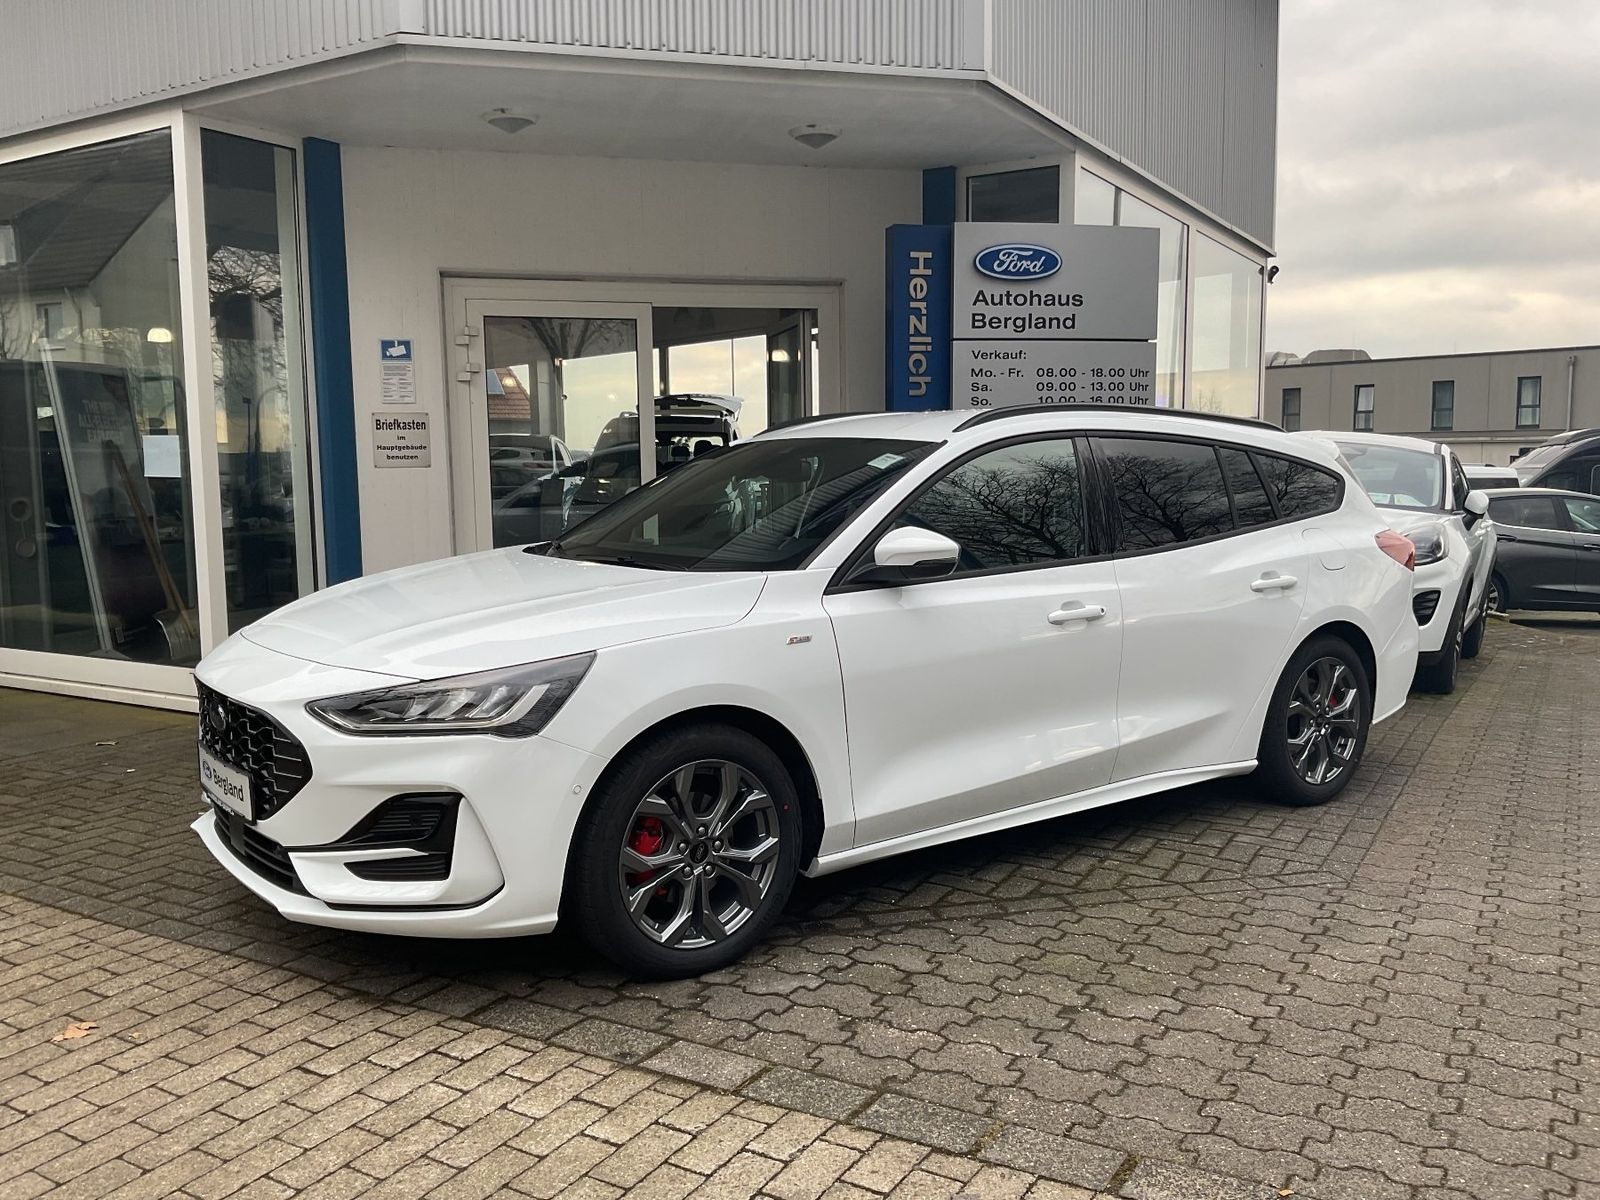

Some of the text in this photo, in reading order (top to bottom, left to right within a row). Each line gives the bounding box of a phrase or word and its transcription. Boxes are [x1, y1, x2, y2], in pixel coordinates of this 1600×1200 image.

[994, 249, 1046, 272] Ford
[972, 290, 1084, 307] Autohaus
[908, 251, 932, 397] Herzlich
[971, 313, 1076, 333] Bergland
[971, 349, 1027, 360] Verkauf:
[971, 367, 997, 378] Mo.
[1008, 367, 1024, 378] Fr.
[1036, 367, 1077, 378] 08.00
[1089, 367, 1125, 378] 18.00
[1129, 368, 1150, 378] Uhr
[971, 382, 993, 392] Sa.
[1036, 382, 1077, 392] 09.00
[1089, 382, 1125, 392] 13.00
[1129, 382, 1149, 392] Uhr
[971, 396, 992, 406] So.
[1038, 396, 1076, 404] 1000
[1089, 396, 1124, 404] 1600
[1129, 396, 1149, 405] Uhr
[375, 418, 427, 431] Briefkasten
[213, 768, 244, 802] Bergland
